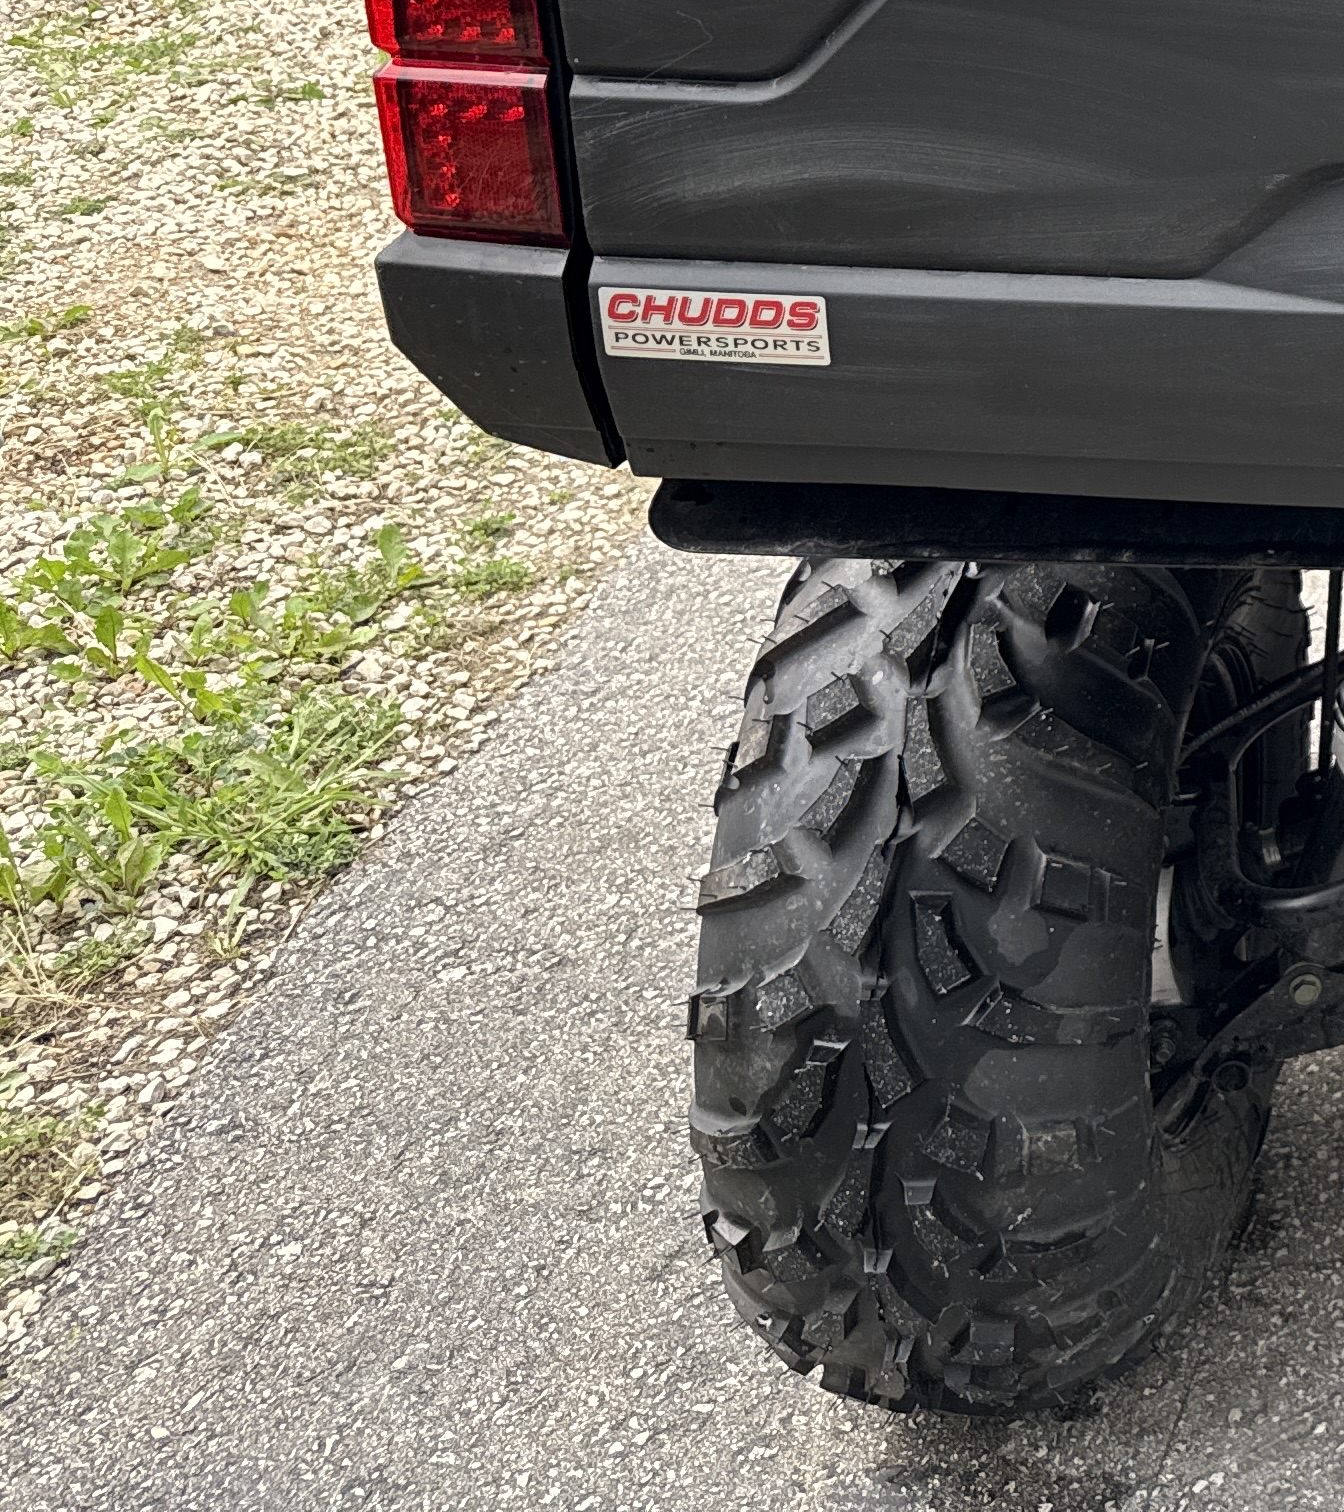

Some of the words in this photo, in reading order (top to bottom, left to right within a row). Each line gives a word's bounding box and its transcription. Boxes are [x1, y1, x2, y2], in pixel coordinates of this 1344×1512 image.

[607, 293, 821, 330] CHUDDS
[614, 331, 821, 352] POWERSPORTS
[709, 349, 757, 359] MANITOBA
